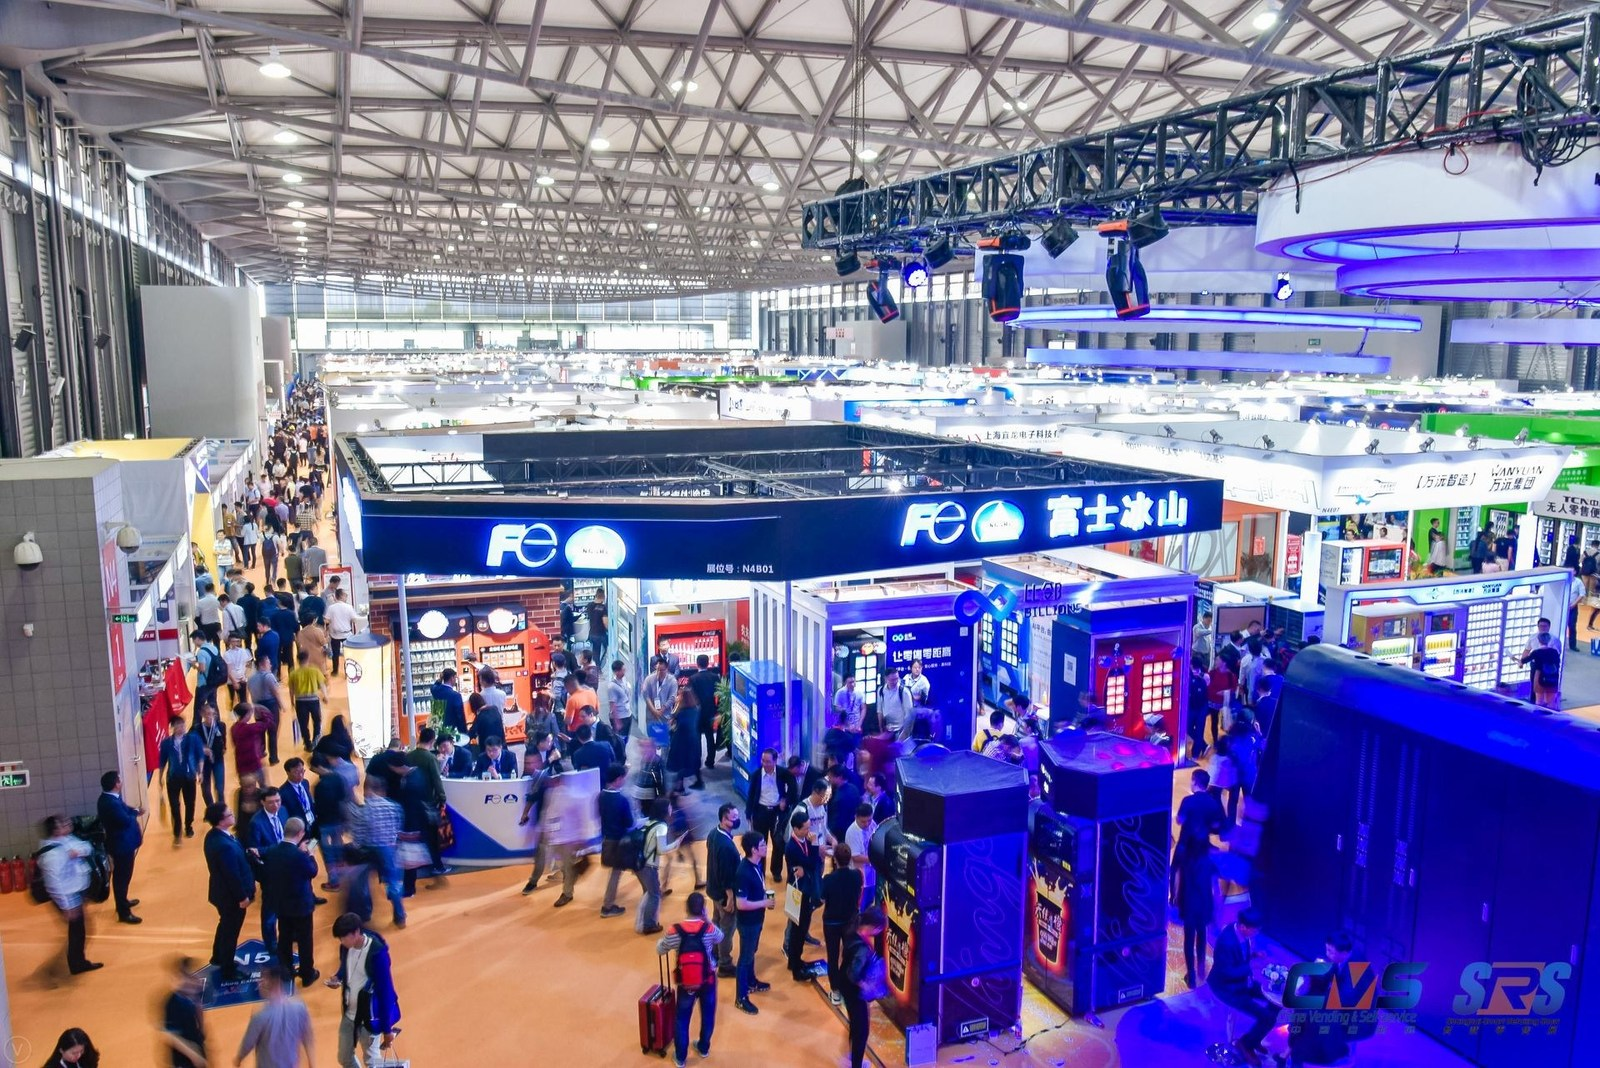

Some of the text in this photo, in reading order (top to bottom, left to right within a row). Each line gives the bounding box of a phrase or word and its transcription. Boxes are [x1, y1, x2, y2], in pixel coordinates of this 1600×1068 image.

[1491, 465, 1544, 477] WANYUAN
[1047, 489, 1188, 538] 富士冰山
